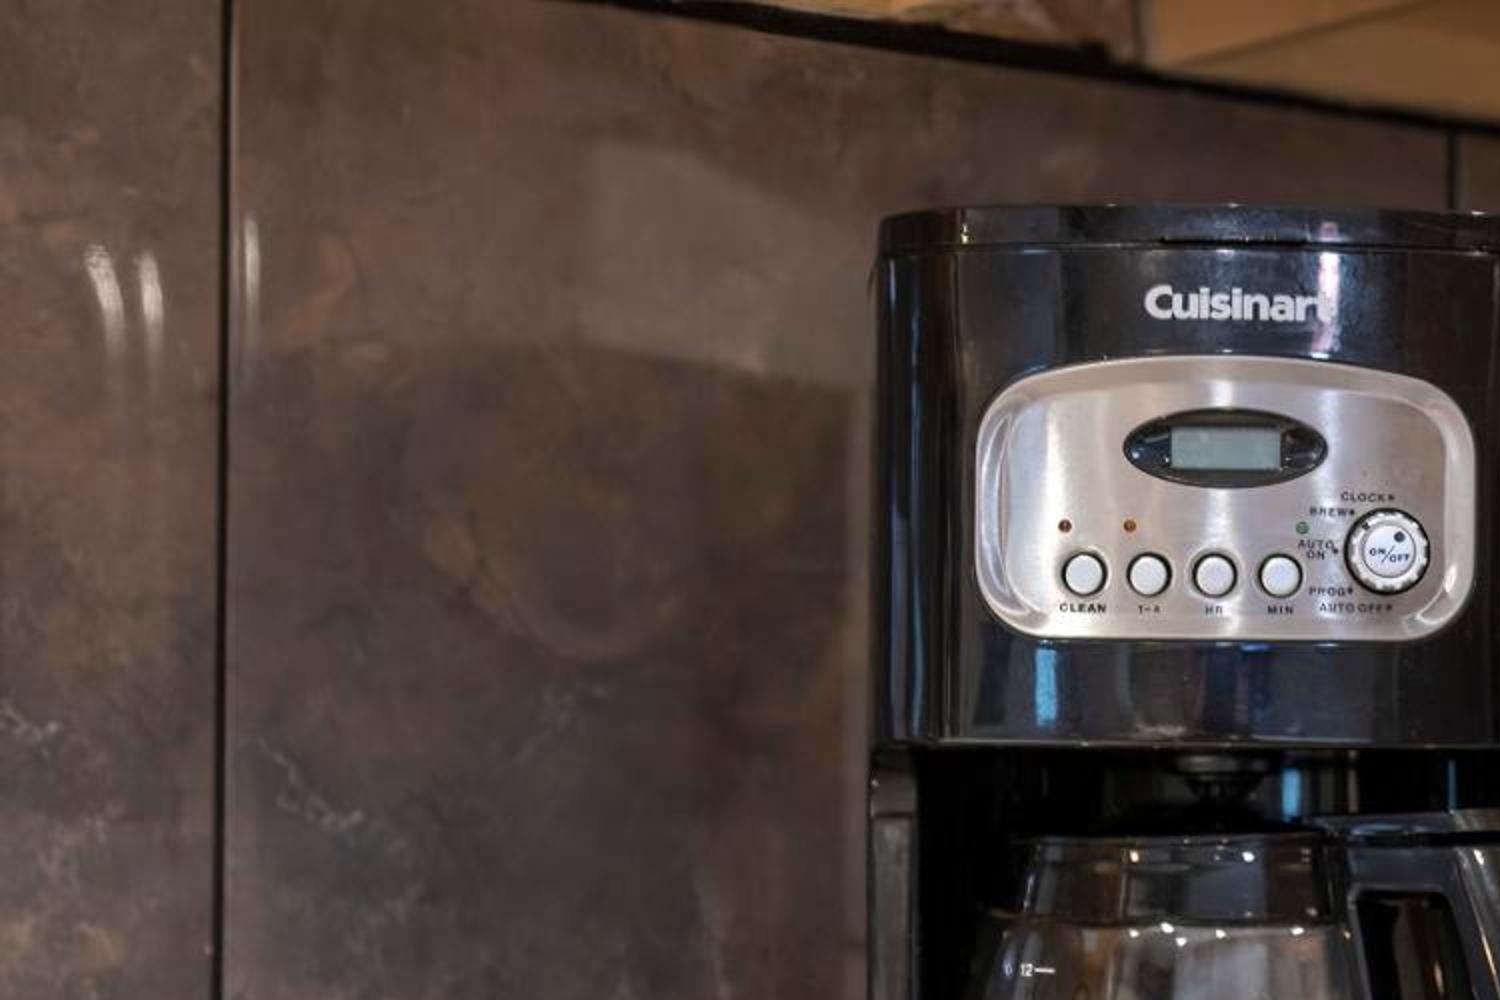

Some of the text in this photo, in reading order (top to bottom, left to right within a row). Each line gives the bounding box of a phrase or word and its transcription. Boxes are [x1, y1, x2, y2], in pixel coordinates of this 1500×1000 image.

[1340, 491, 1386, 503] CLOCK
[1309, 507, 1349, 517] BREW
[1297, 539, 1335, 549] AUTO
[1306, 550, 1326, 560] ON
[1308, 586, 1347, 597] PROG
[1059, 602, 1107, 614] CLEAN
[1267, 604, 1294, 615] MIN
[1319, 602, 1386, 613] AUTO OFF
[1020, 963, 1034, 977] 12
